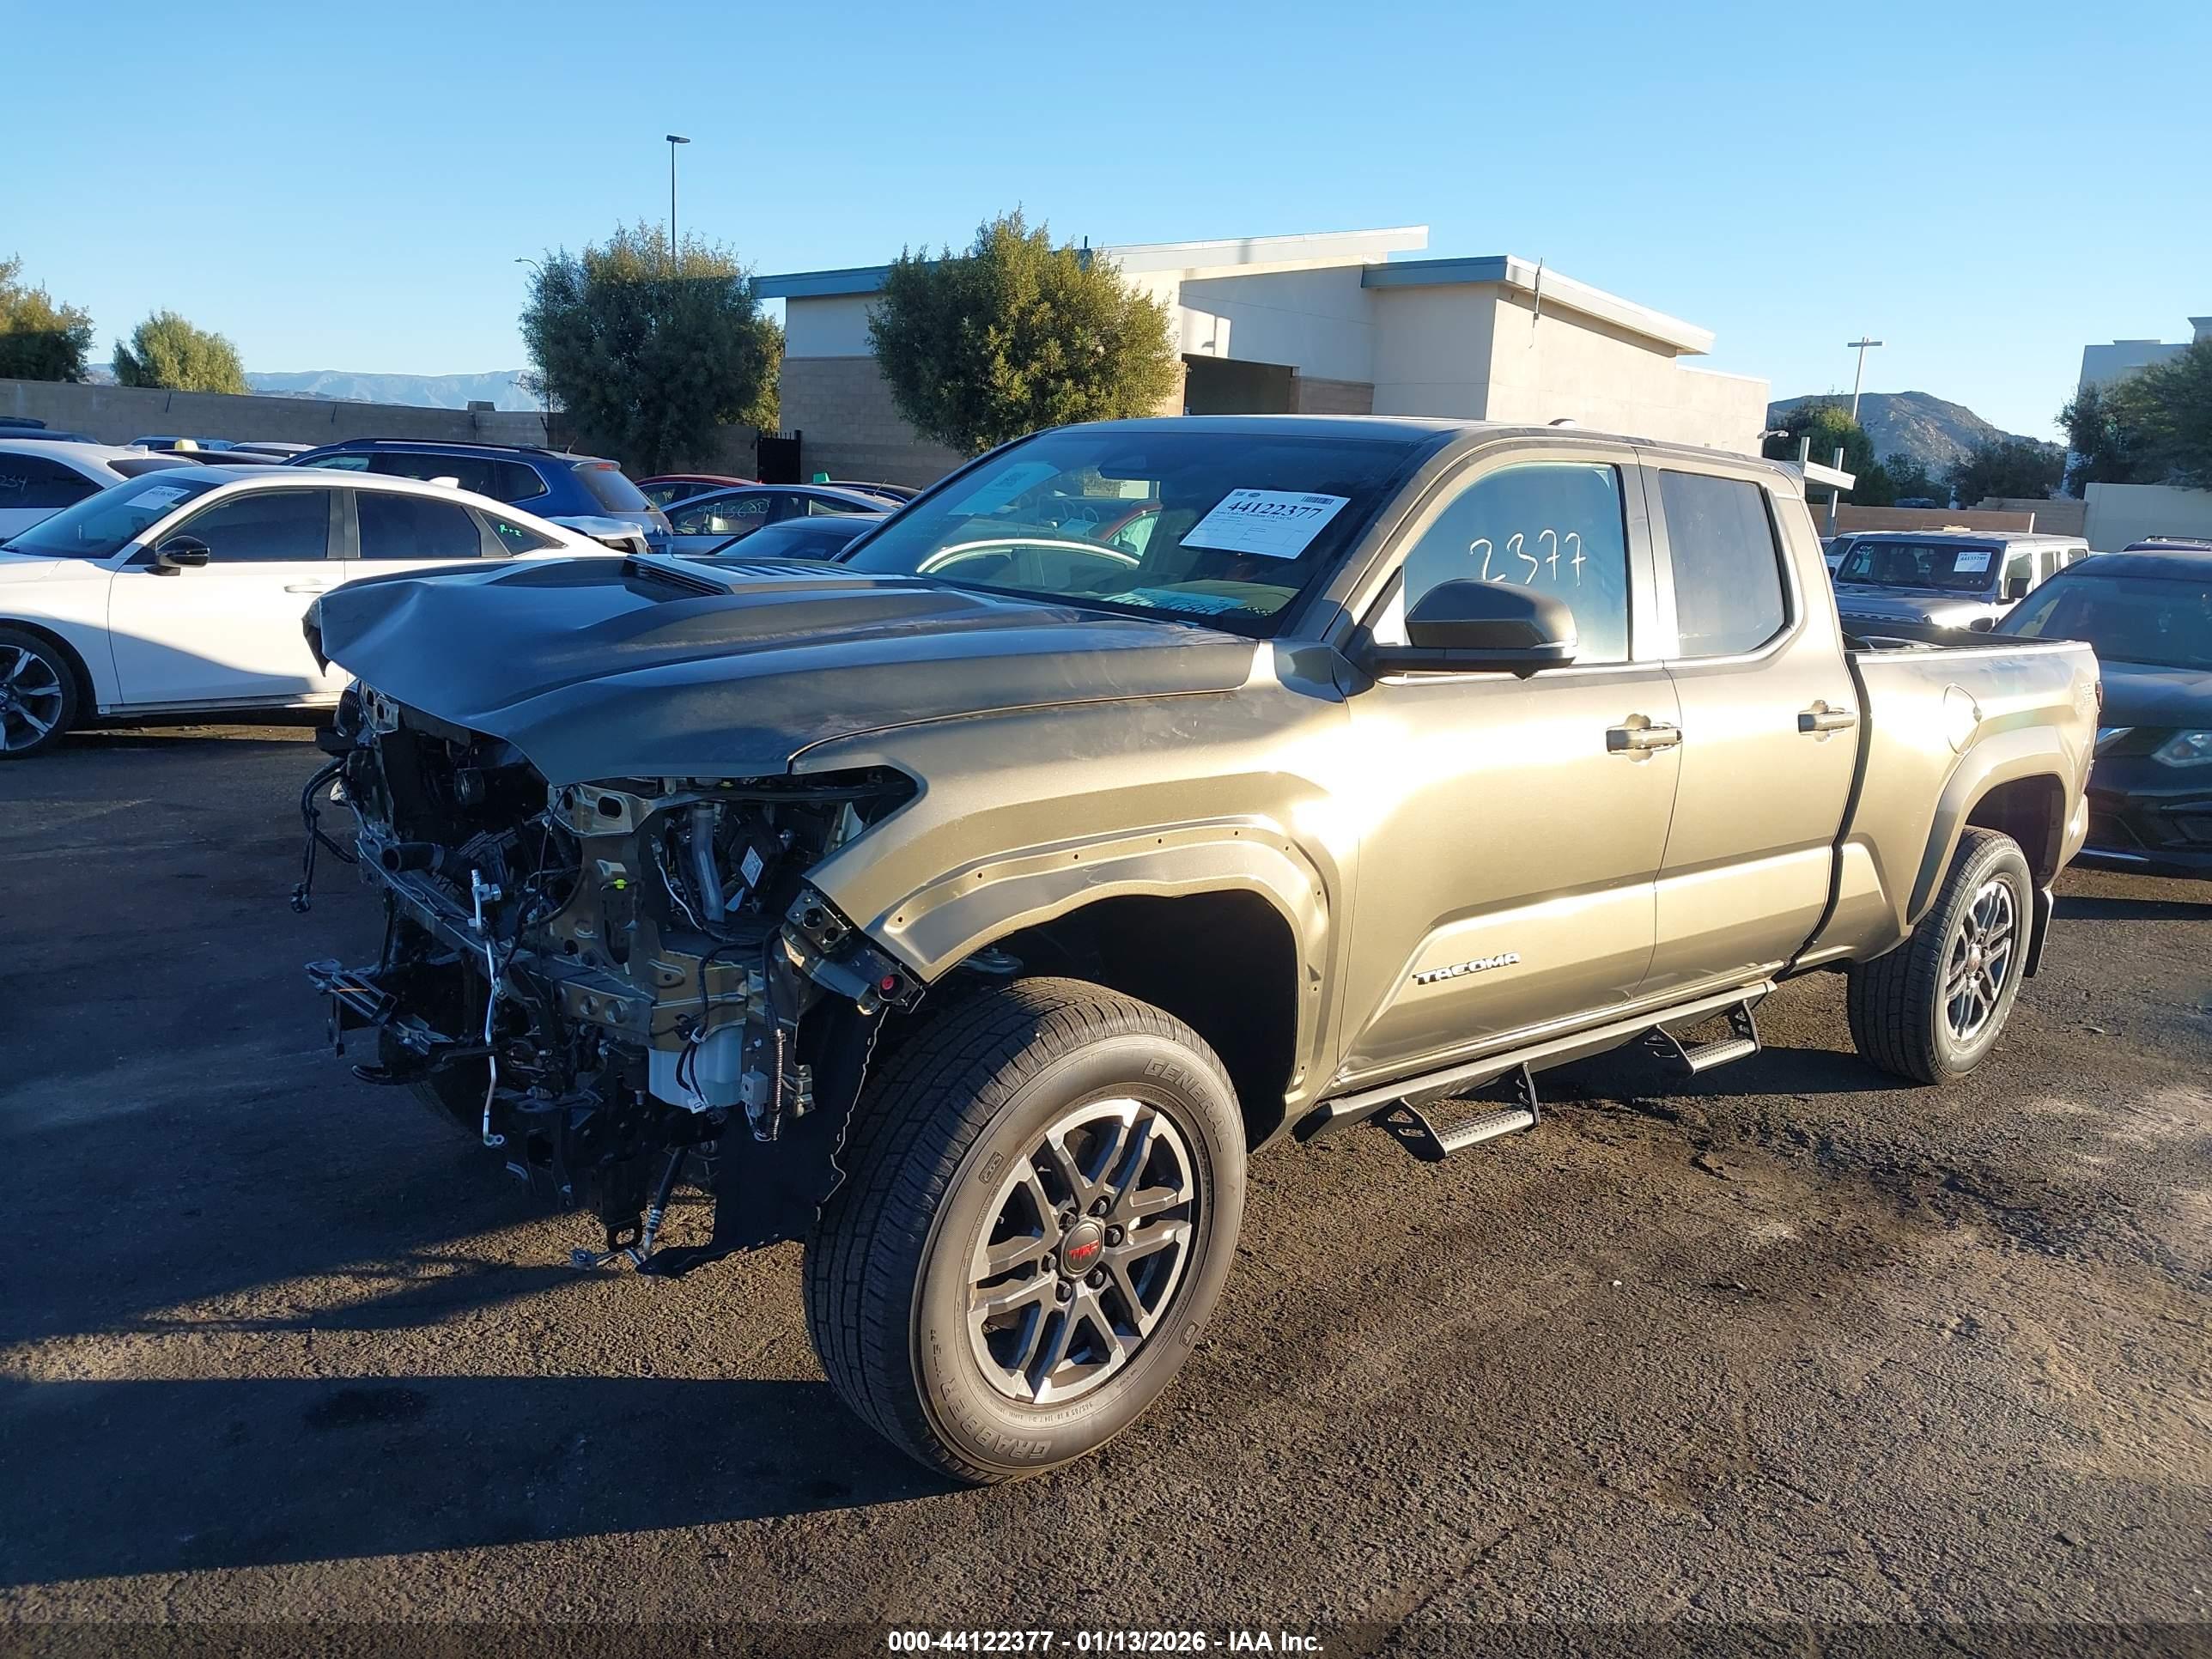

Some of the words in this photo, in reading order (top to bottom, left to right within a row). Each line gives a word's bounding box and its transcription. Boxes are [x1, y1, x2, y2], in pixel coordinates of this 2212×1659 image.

[1227, 501, 1324, 520] 44122377
[1469, 529, 1587, 587] 2377
[1412, 951, 1521, 986] TACOMA
[1143, 1058, 1231, 1152] GENERAL
[1067, 1239, 1100, 1262] TRD
[939, 1377, 1052, 1459] GRABBER
